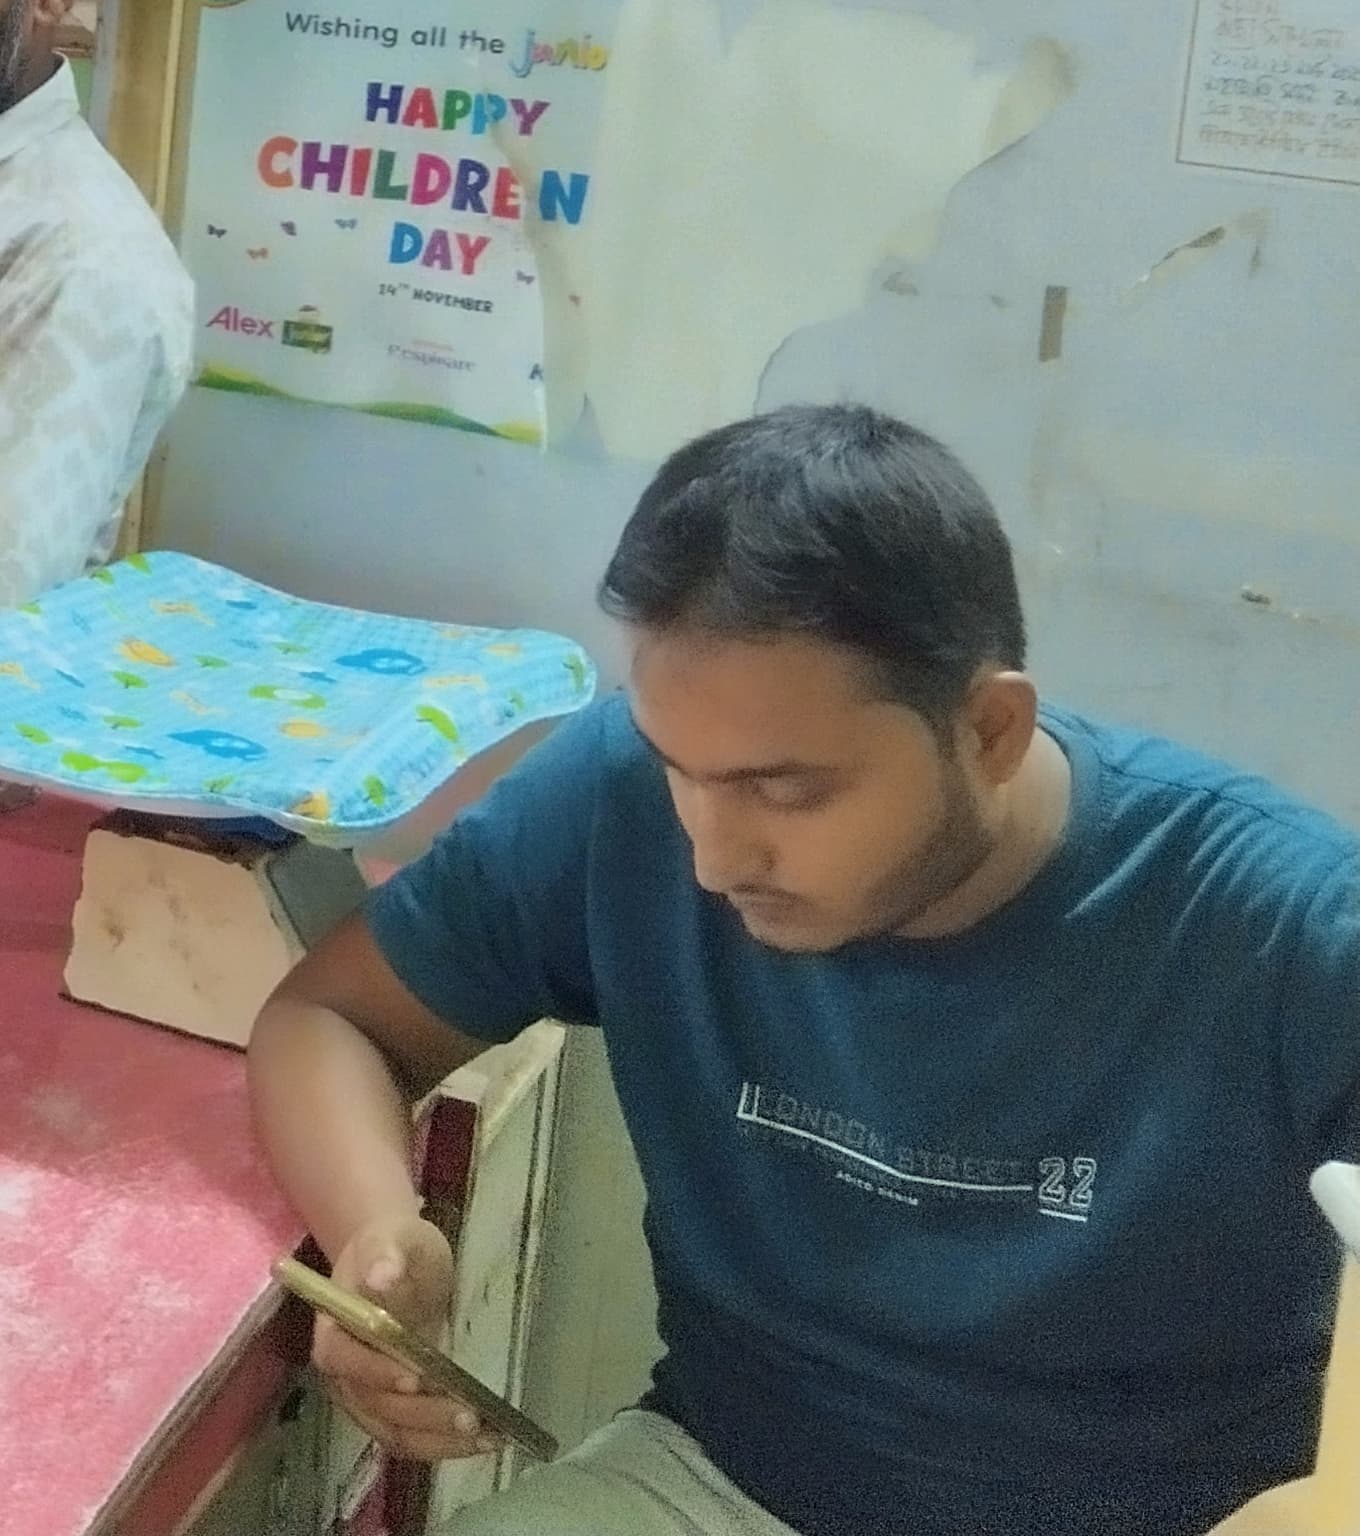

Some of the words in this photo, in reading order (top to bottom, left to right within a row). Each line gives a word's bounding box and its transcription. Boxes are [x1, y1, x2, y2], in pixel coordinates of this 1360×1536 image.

[284, 11, 399, 48] Wishing
[411, 26, 447, 48] all
[458, 29, 506, 54] the
[364, 81, 551, 136] HAPPY
[389, 220, 493, 277] DAY
[204, 304, 275, 339] Alex
[412, 287, 494, 314] NOVEMBER
[1038, 1156, 1098, 1208] 22
